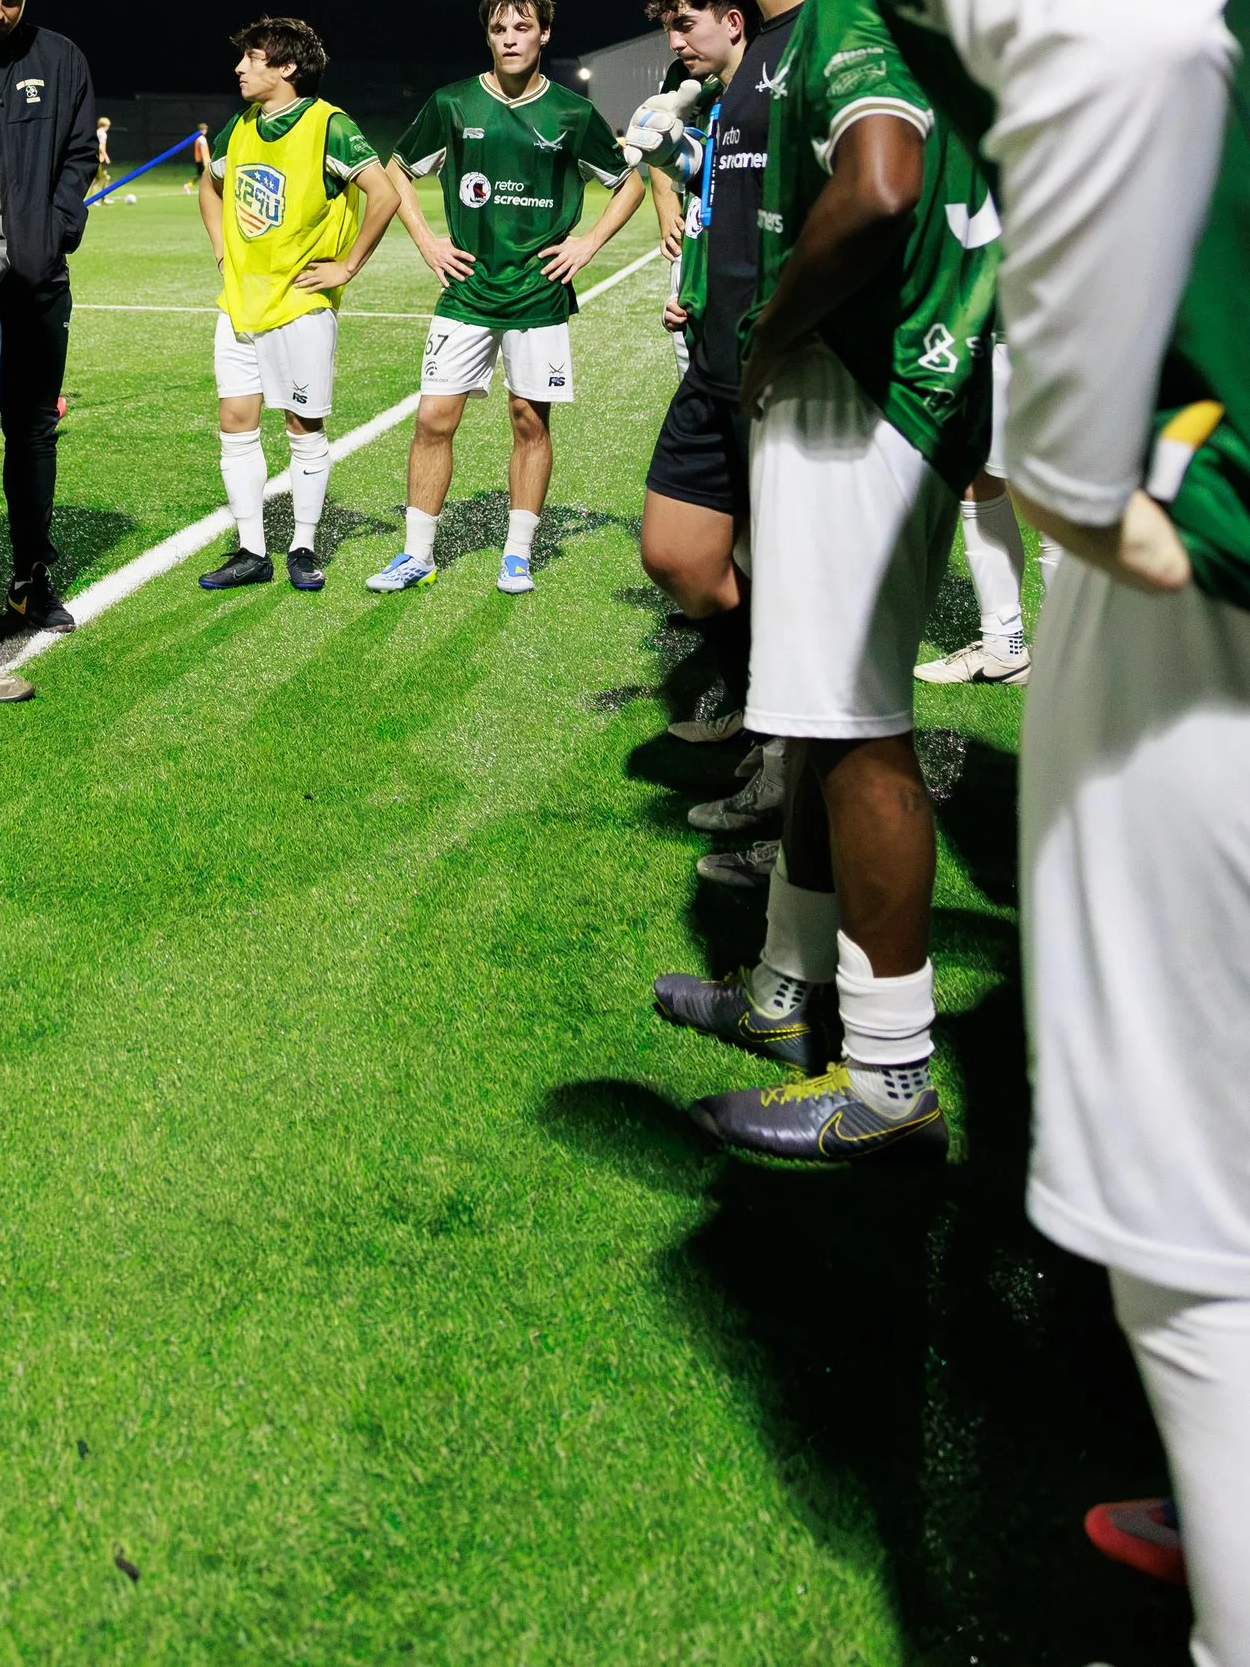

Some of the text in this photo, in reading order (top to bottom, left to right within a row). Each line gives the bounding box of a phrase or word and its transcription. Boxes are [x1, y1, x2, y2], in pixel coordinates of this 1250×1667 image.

[494, 179, 525, 192] retro
[493, 195, 554, 209] screamers
[292, 391, 308, 404] RS
